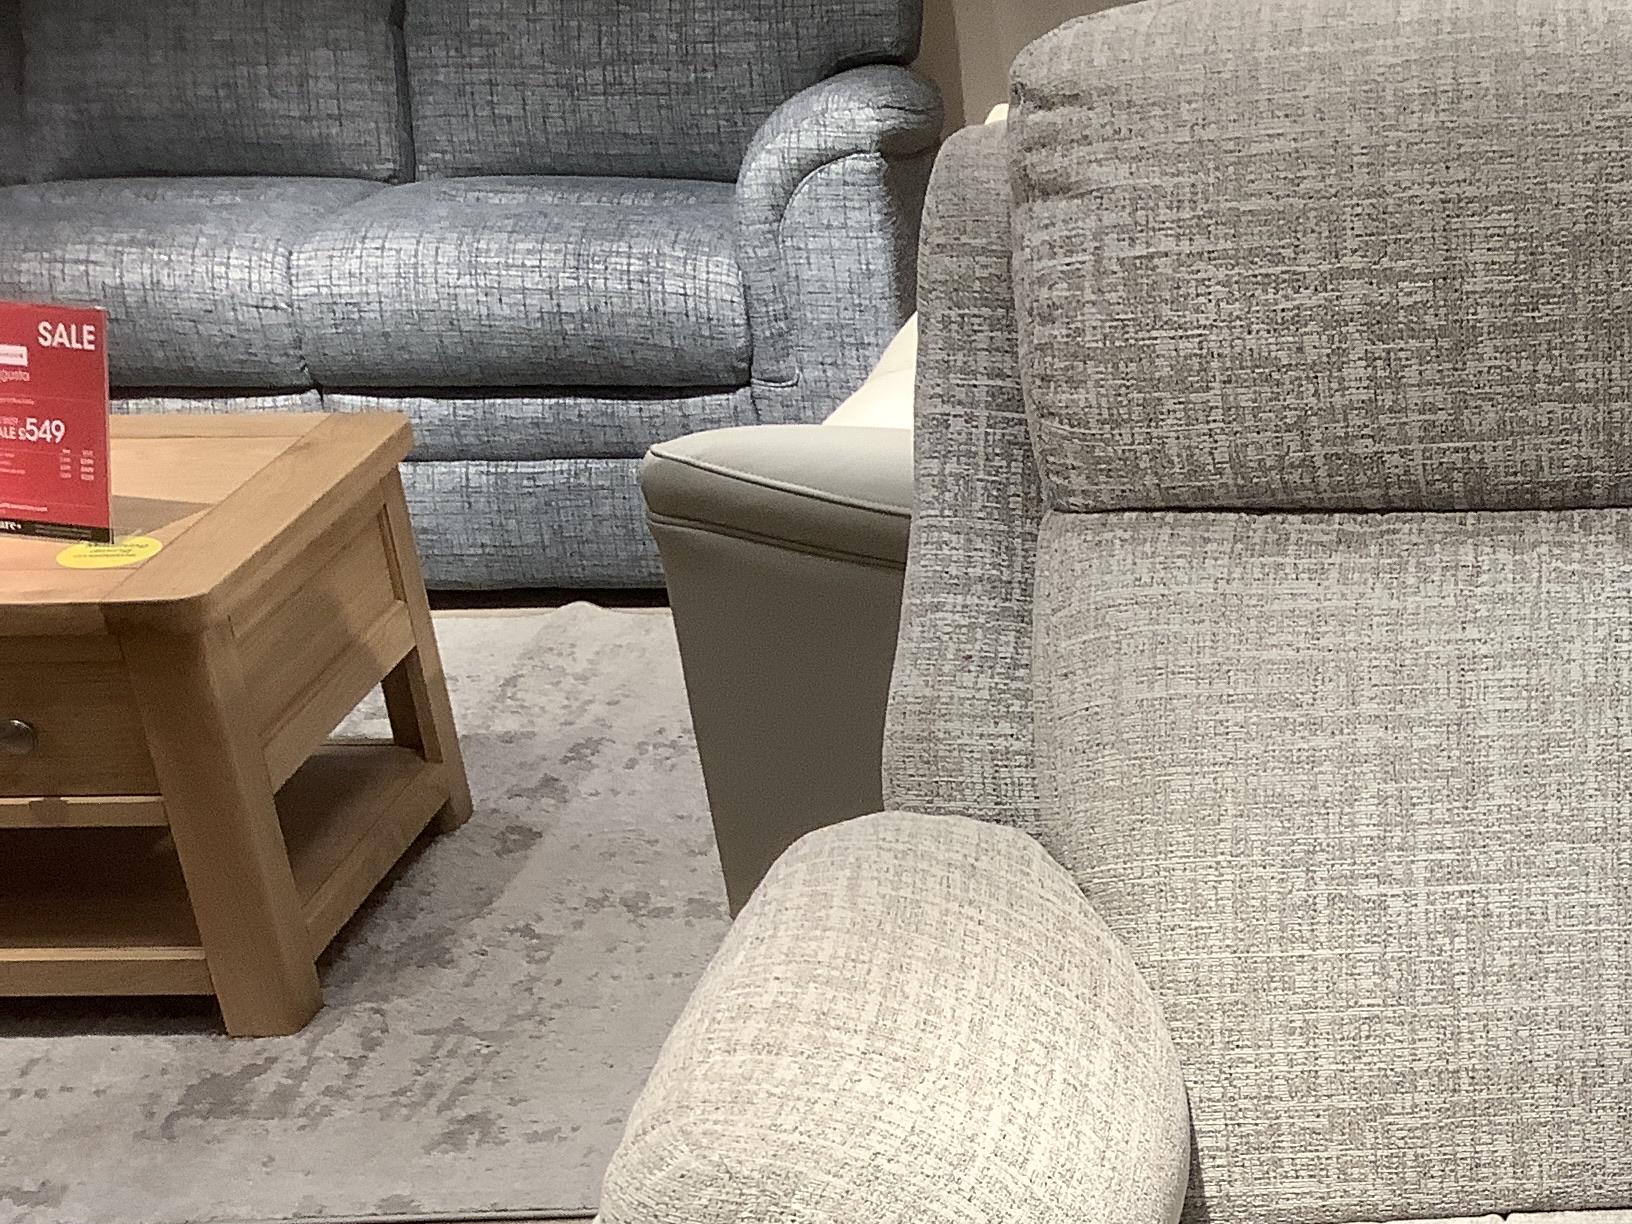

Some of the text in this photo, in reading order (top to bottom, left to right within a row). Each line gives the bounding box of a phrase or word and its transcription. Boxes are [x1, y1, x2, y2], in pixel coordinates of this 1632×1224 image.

[38, 321, 95, 350] SALE
[0, 425, 17, 439] ALE
[18, 417, 65, 444] £549
